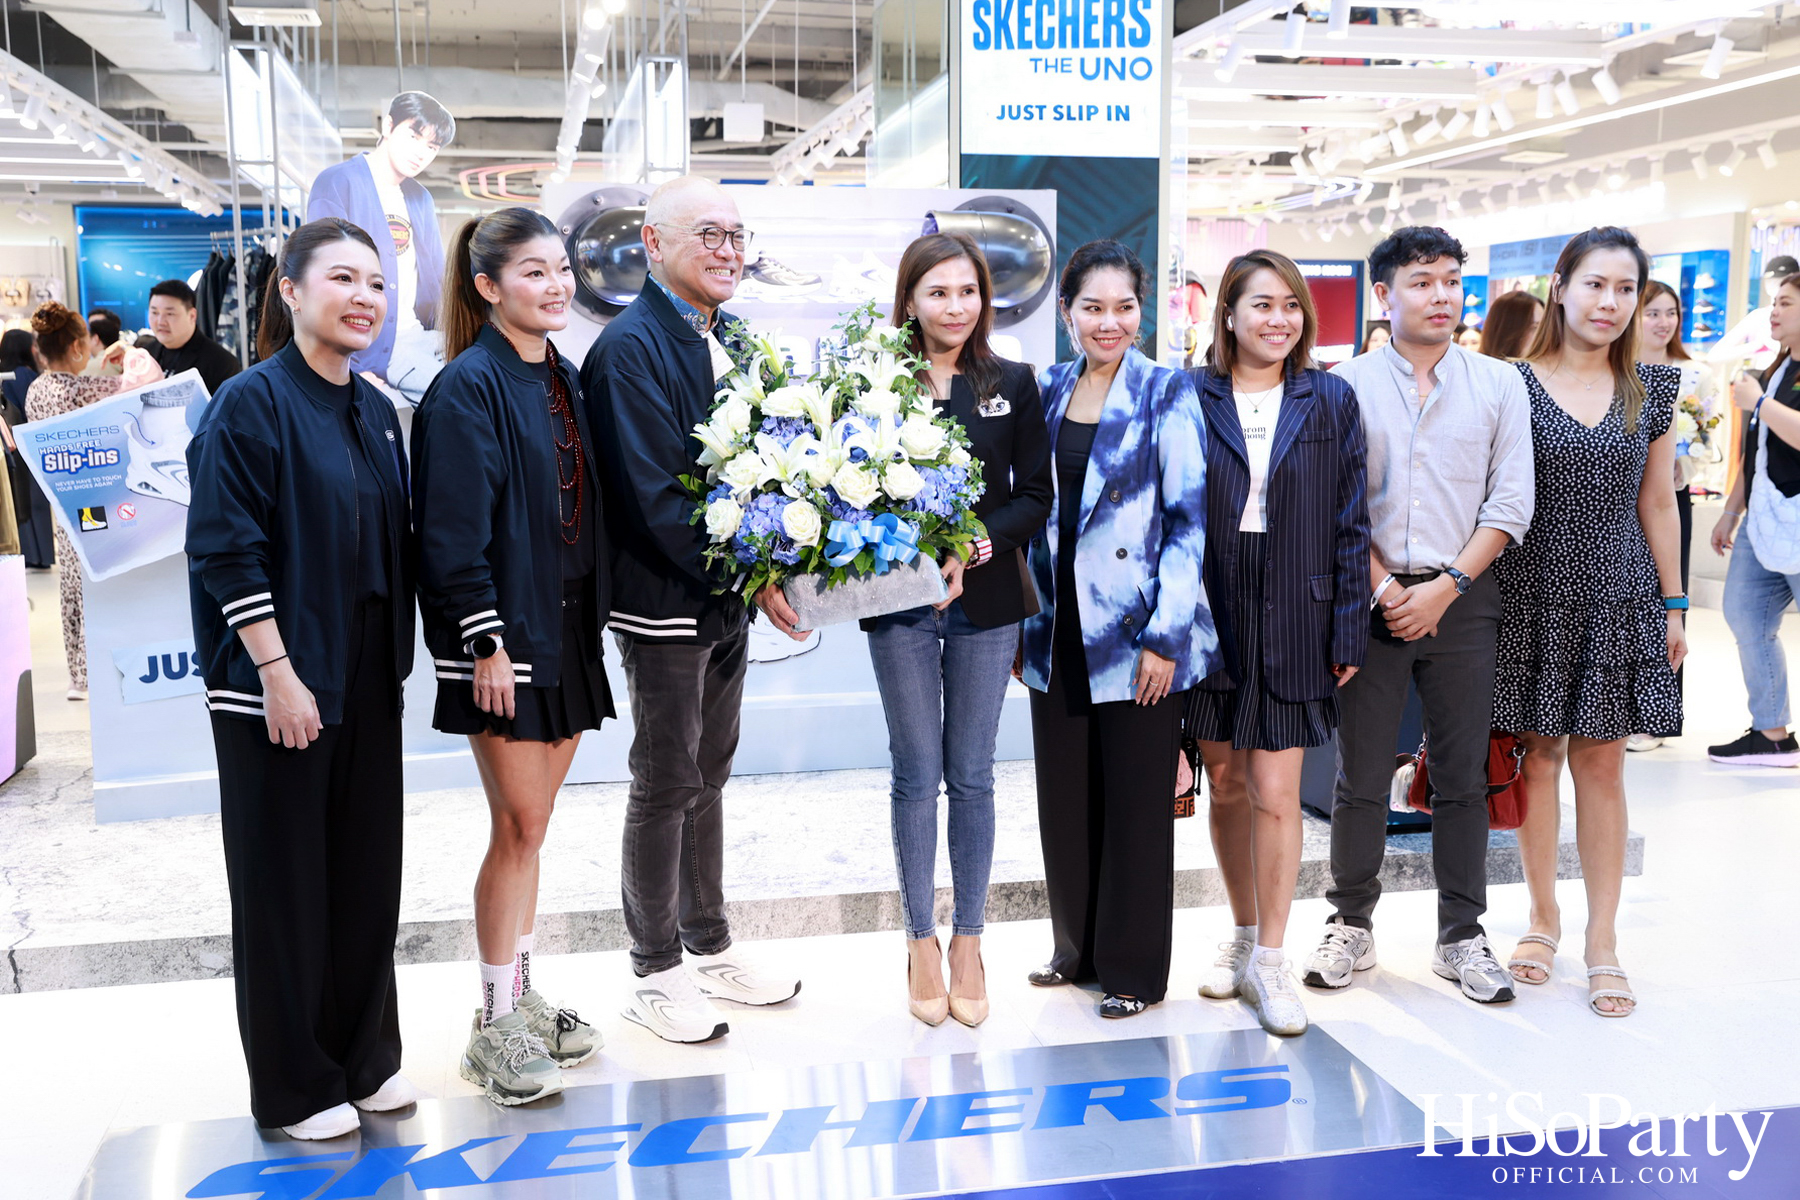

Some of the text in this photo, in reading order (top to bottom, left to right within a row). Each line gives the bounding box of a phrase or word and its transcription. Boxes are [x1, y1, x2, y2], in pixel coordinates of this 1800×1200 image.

[972, 0, 1152, 50] SKECHERS
[1029, 56, 1153, 82] THE UNO
[996, 104, 1131, 122] JUST SLIP IN
[35, 425, 120, 442] SKECHERS
[39, 438, 103, 455] HANDS FREE
[43, 447, 119, 473] Slip-ins
[55, 480, 75, 488] NEVER
[101, 474, 122, 482] TOUCH
[73, 483, 94, 491] SHOES
[483, 981, 494, 1029] SKECHERS
[185, 1064, 1291, 1200] SKECHERS
